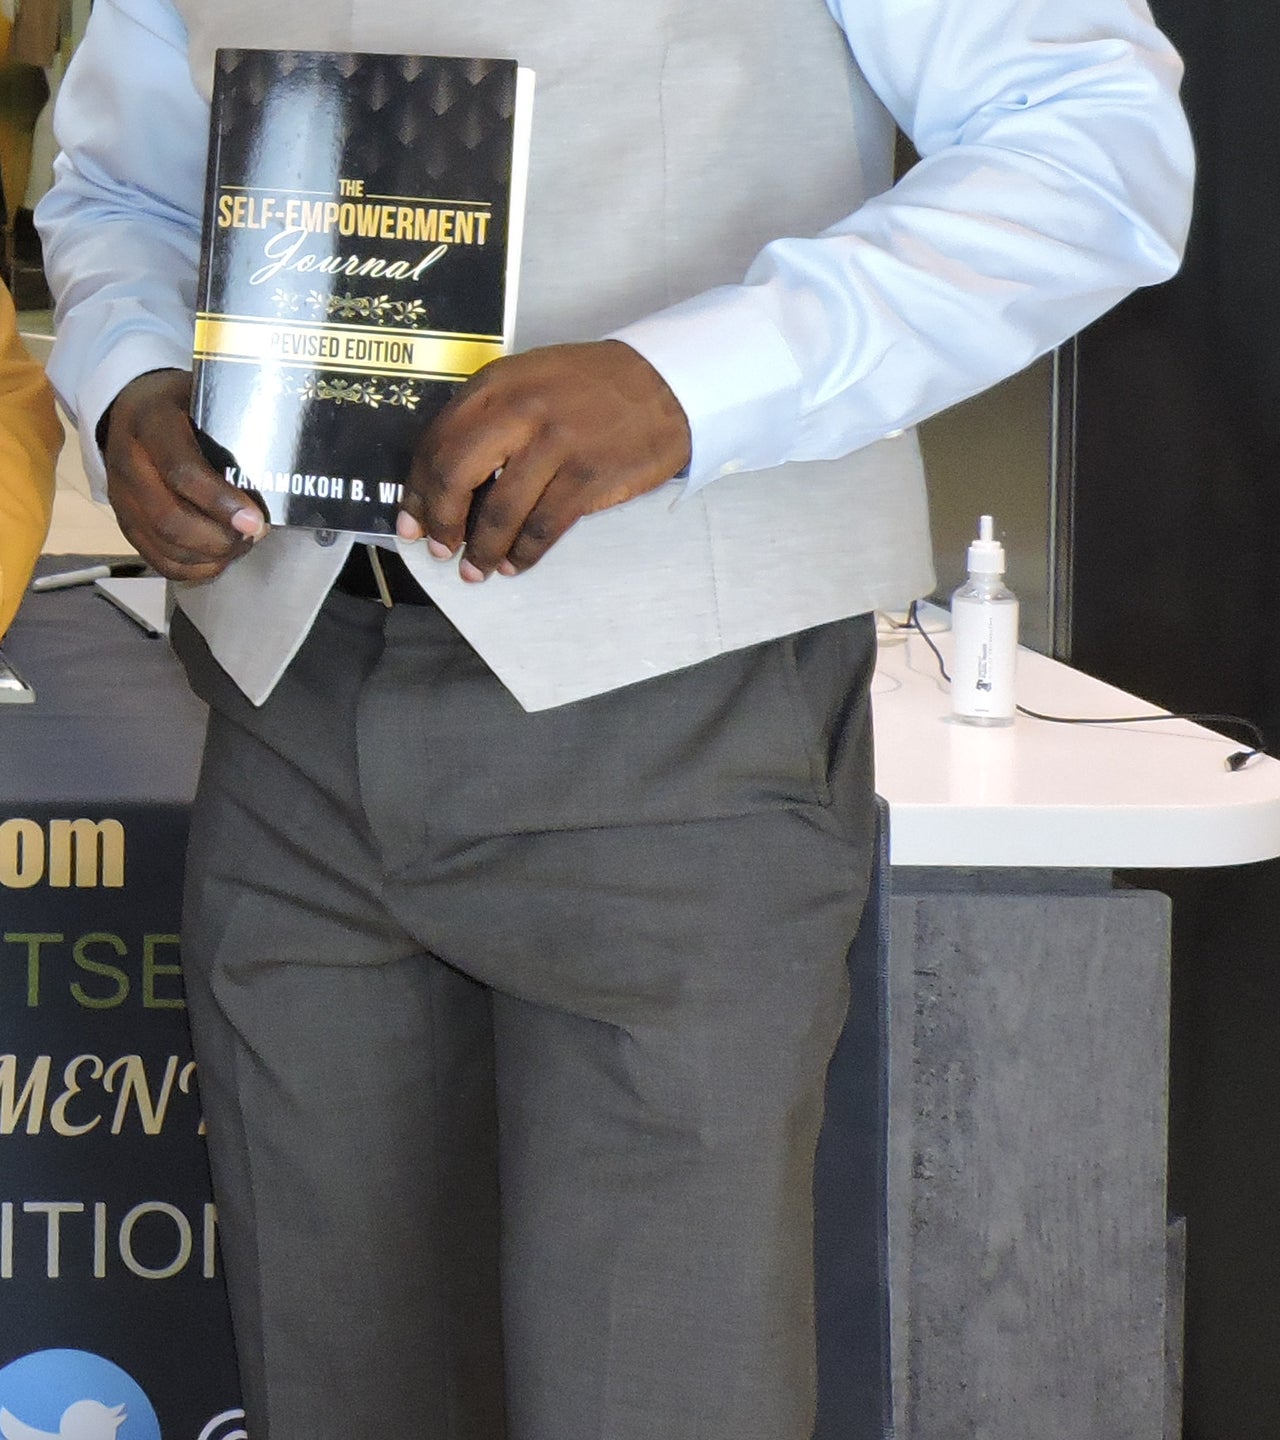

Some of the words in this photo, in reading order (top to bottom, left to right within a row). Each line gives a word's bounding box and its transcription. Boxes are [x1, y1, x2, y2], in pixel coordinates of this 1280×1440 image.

[338, 179, 366, 198] THE
[217, 194, 492, 245] SELF-EMPOWERMENT
[250, 227, 448, 285] Journal
[345, 338, 415, 364] EDITION
[351, 479, 371, 502] B.
